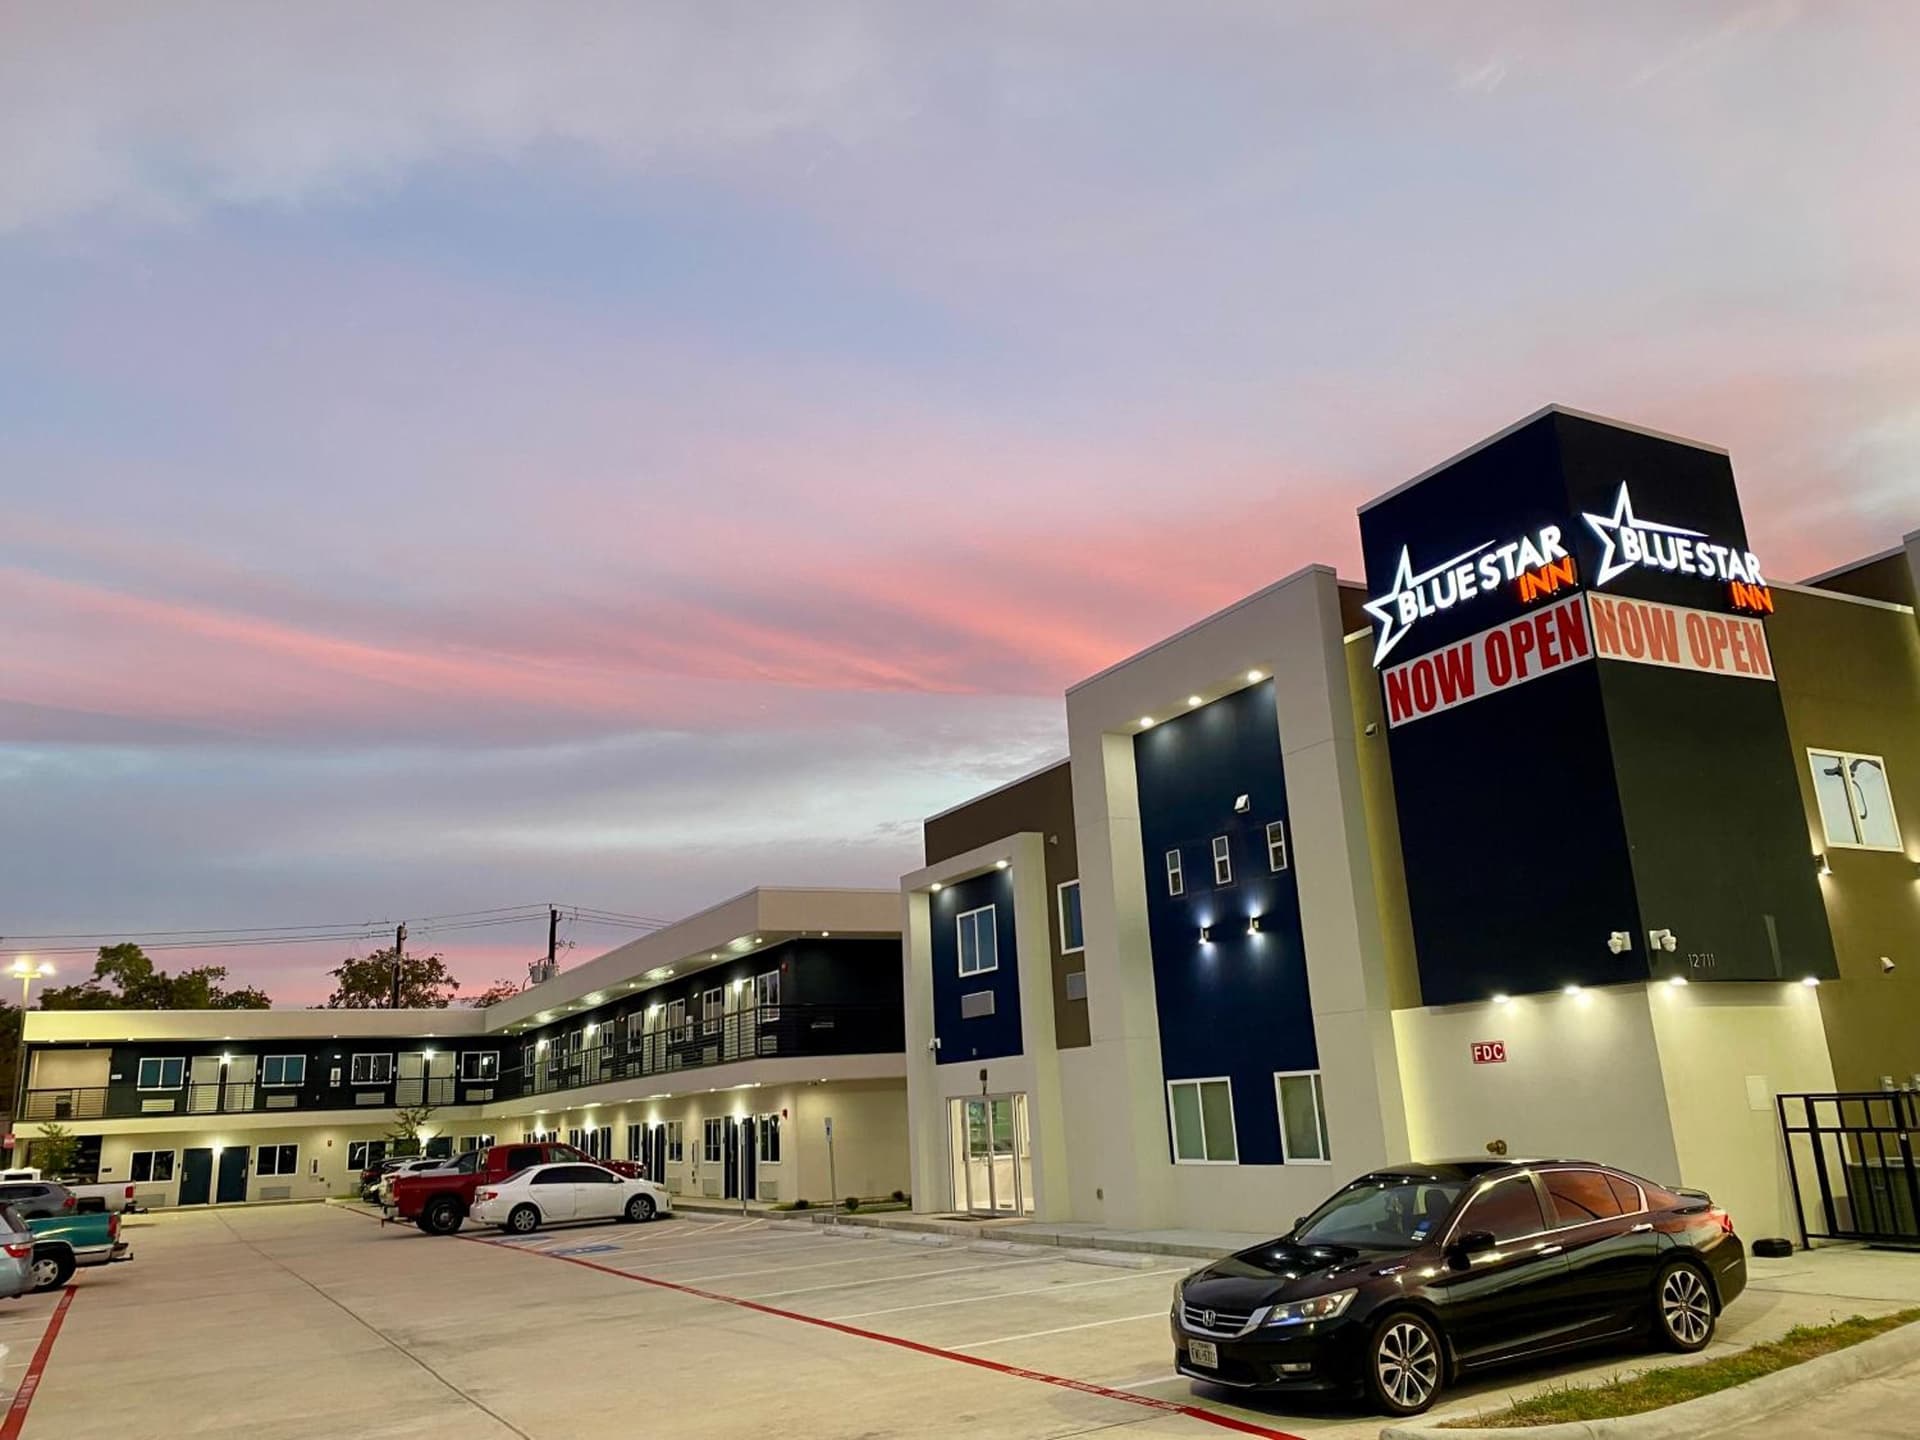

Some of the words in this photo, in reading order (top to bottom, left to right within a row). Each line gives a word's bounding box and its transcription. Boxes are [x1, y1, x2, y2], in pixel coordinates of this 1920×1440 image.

[1519, 555, 1576, 604] INN
[1731, 581, 1775, 614] INN
[1590, 596, 1680, 663] NOW
[1685, 613, 1771, 676] OPEN
[1386, 642, 1475, 723] NOW
[1484, 598, 1589, 687] OPEN
[1687, 953, 1716, 968] 12711
[1474, 1044, 1504, 1060] FDC
